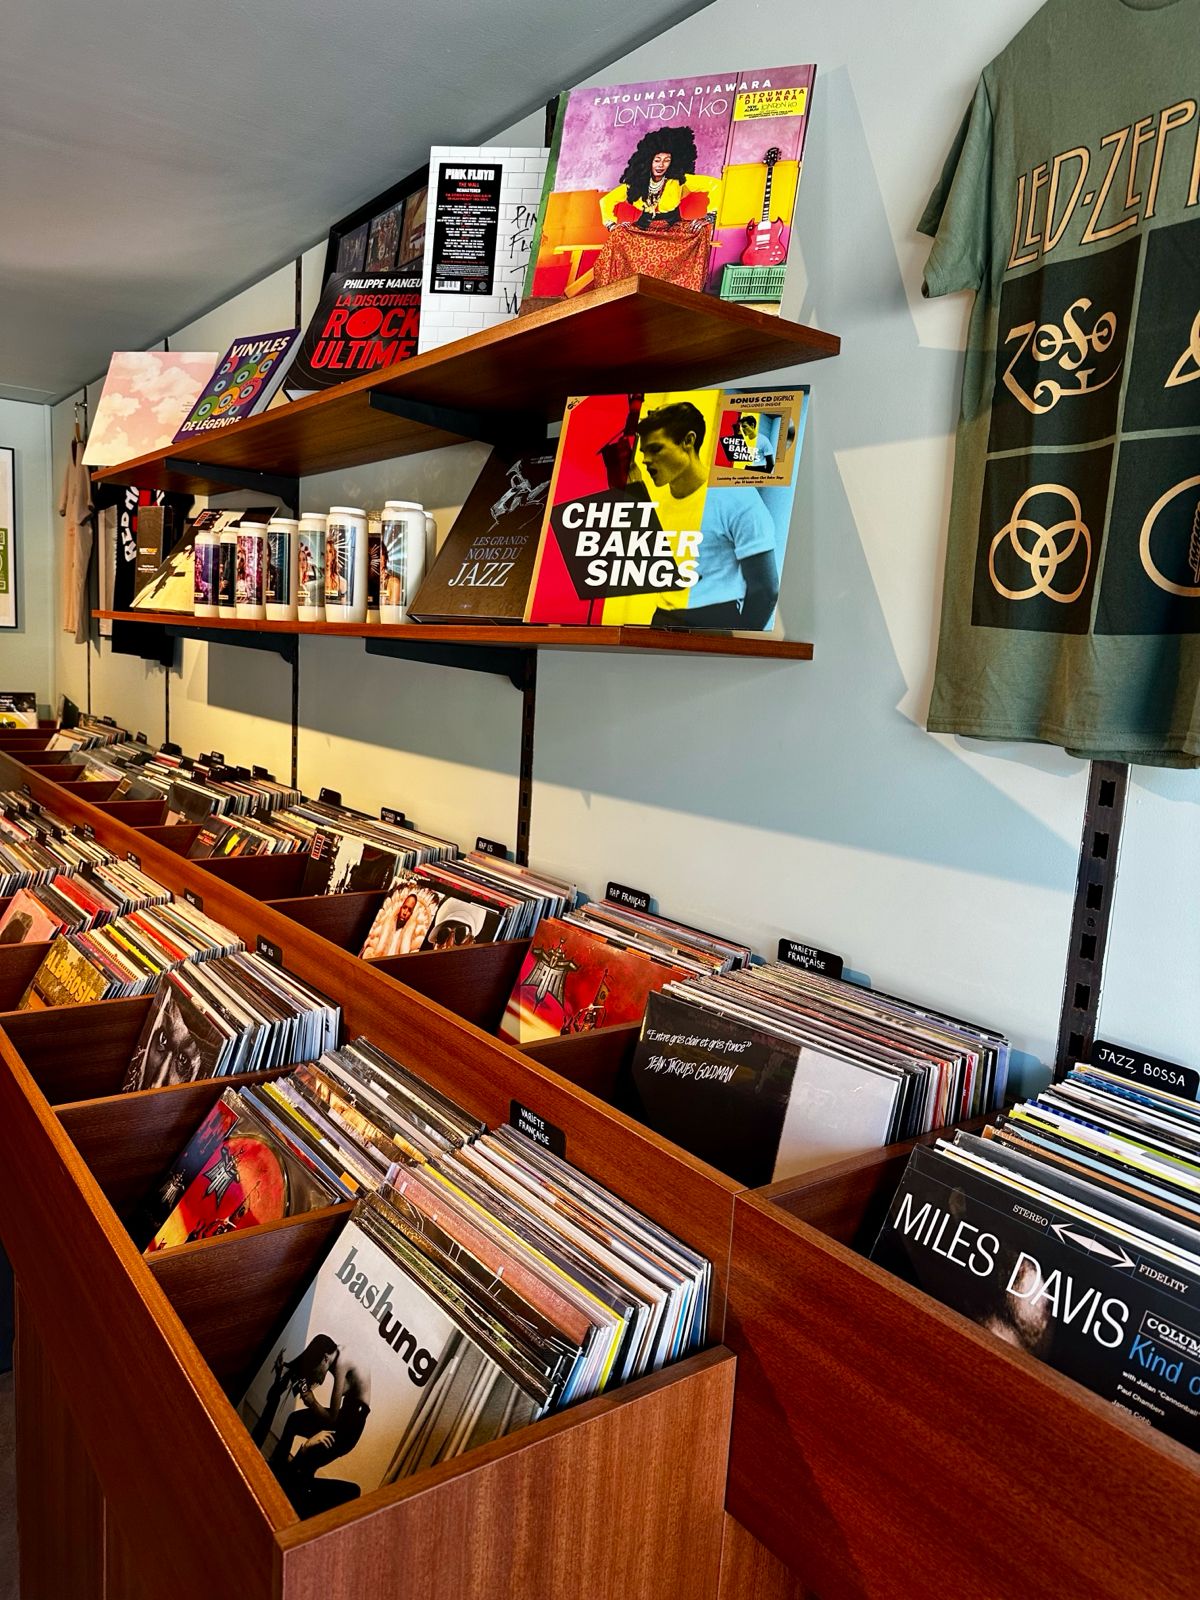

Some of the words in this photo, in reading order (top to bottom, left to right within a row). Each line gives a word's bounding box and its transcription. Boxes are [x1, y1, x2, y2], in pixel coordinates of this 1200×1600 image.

[594, 88, 685, 106] FATOUMATA
[694, 79, 772, 95] DIAWARA
[739, 89, 805, 101] FATOUMATA
[744, 95, 797, 105] DIAWARA
[613, 96, 694, 127] LONDON
[699, 98, 728, 118] KO
[445, 168, 467, 180] PINK
[467, 169, 495, 181] FLOYD
[1006, 98, 1200, 272] LED-ZEP
[343, 278, 386, 289] PHILIPPE
[336, 295, 351, 307] LA
[321, 307, 421, 338] ROCK
[230, 336, 291, 358] VINYLES
[310, 340, 417, 369] ULTIME
[729, 396, 760, 405] BONUS
[181, 420, 198, 432] DE
[195, 416, 242, 431] LÉGENDE
[722, 437, 746, 446] CHET
[728, 445, 759, 455] BAKER
[733, 453, 761, 462] SINGS
[561, 501, 660, 529] CHET
[473, 537, 491, 546] LES
[490, 535, 530, 545] GRANDS
[575, 530, 704, 557] BAKER
[464, 548, 500, 561] NOMS
[500, 547, 523, 560] DU
[448, 562, 516, 587] JAZZ
[584, 559, 701, 588] SINGS
[608, 887, 620, 897] RAP
[44, 950, 98, 1003] ALBOROSIE
[669, 1034, 685, 1046] gris
[684, 1035, 700, 1046] clair
[699, 1037, 709, 1048] et
[708, 1038, 724, 1052] gris
[694, 1062, 739, 1084] GOLDMAN
[1098, 1047, 1139, 1076] JAZZ,
[1143, 1062, 1186, 1088] BOSSA
[1012, 1203, 1049, 1228] STEREO
[1138, 1263, 1189, 1295] FIDELITY
[893, 1192, 1000, 1278] MILES
[1005, 1251, 1130, 1349] DAVIS
[334, 1245, 438, 1388] bashung
[1128, 1333, 1184, 1384] Kind
[1122, 1370, 1137, 1382] with
[1136, 1378, 1157, 1394] Julian
[1116, 1384, 1133, 1397] Paul
[1132, 1393, 1165, 1416] Chambers
[1111, 1399, 1133, 1415] James
[1133, 1411, 1152, 1426] Cobb
